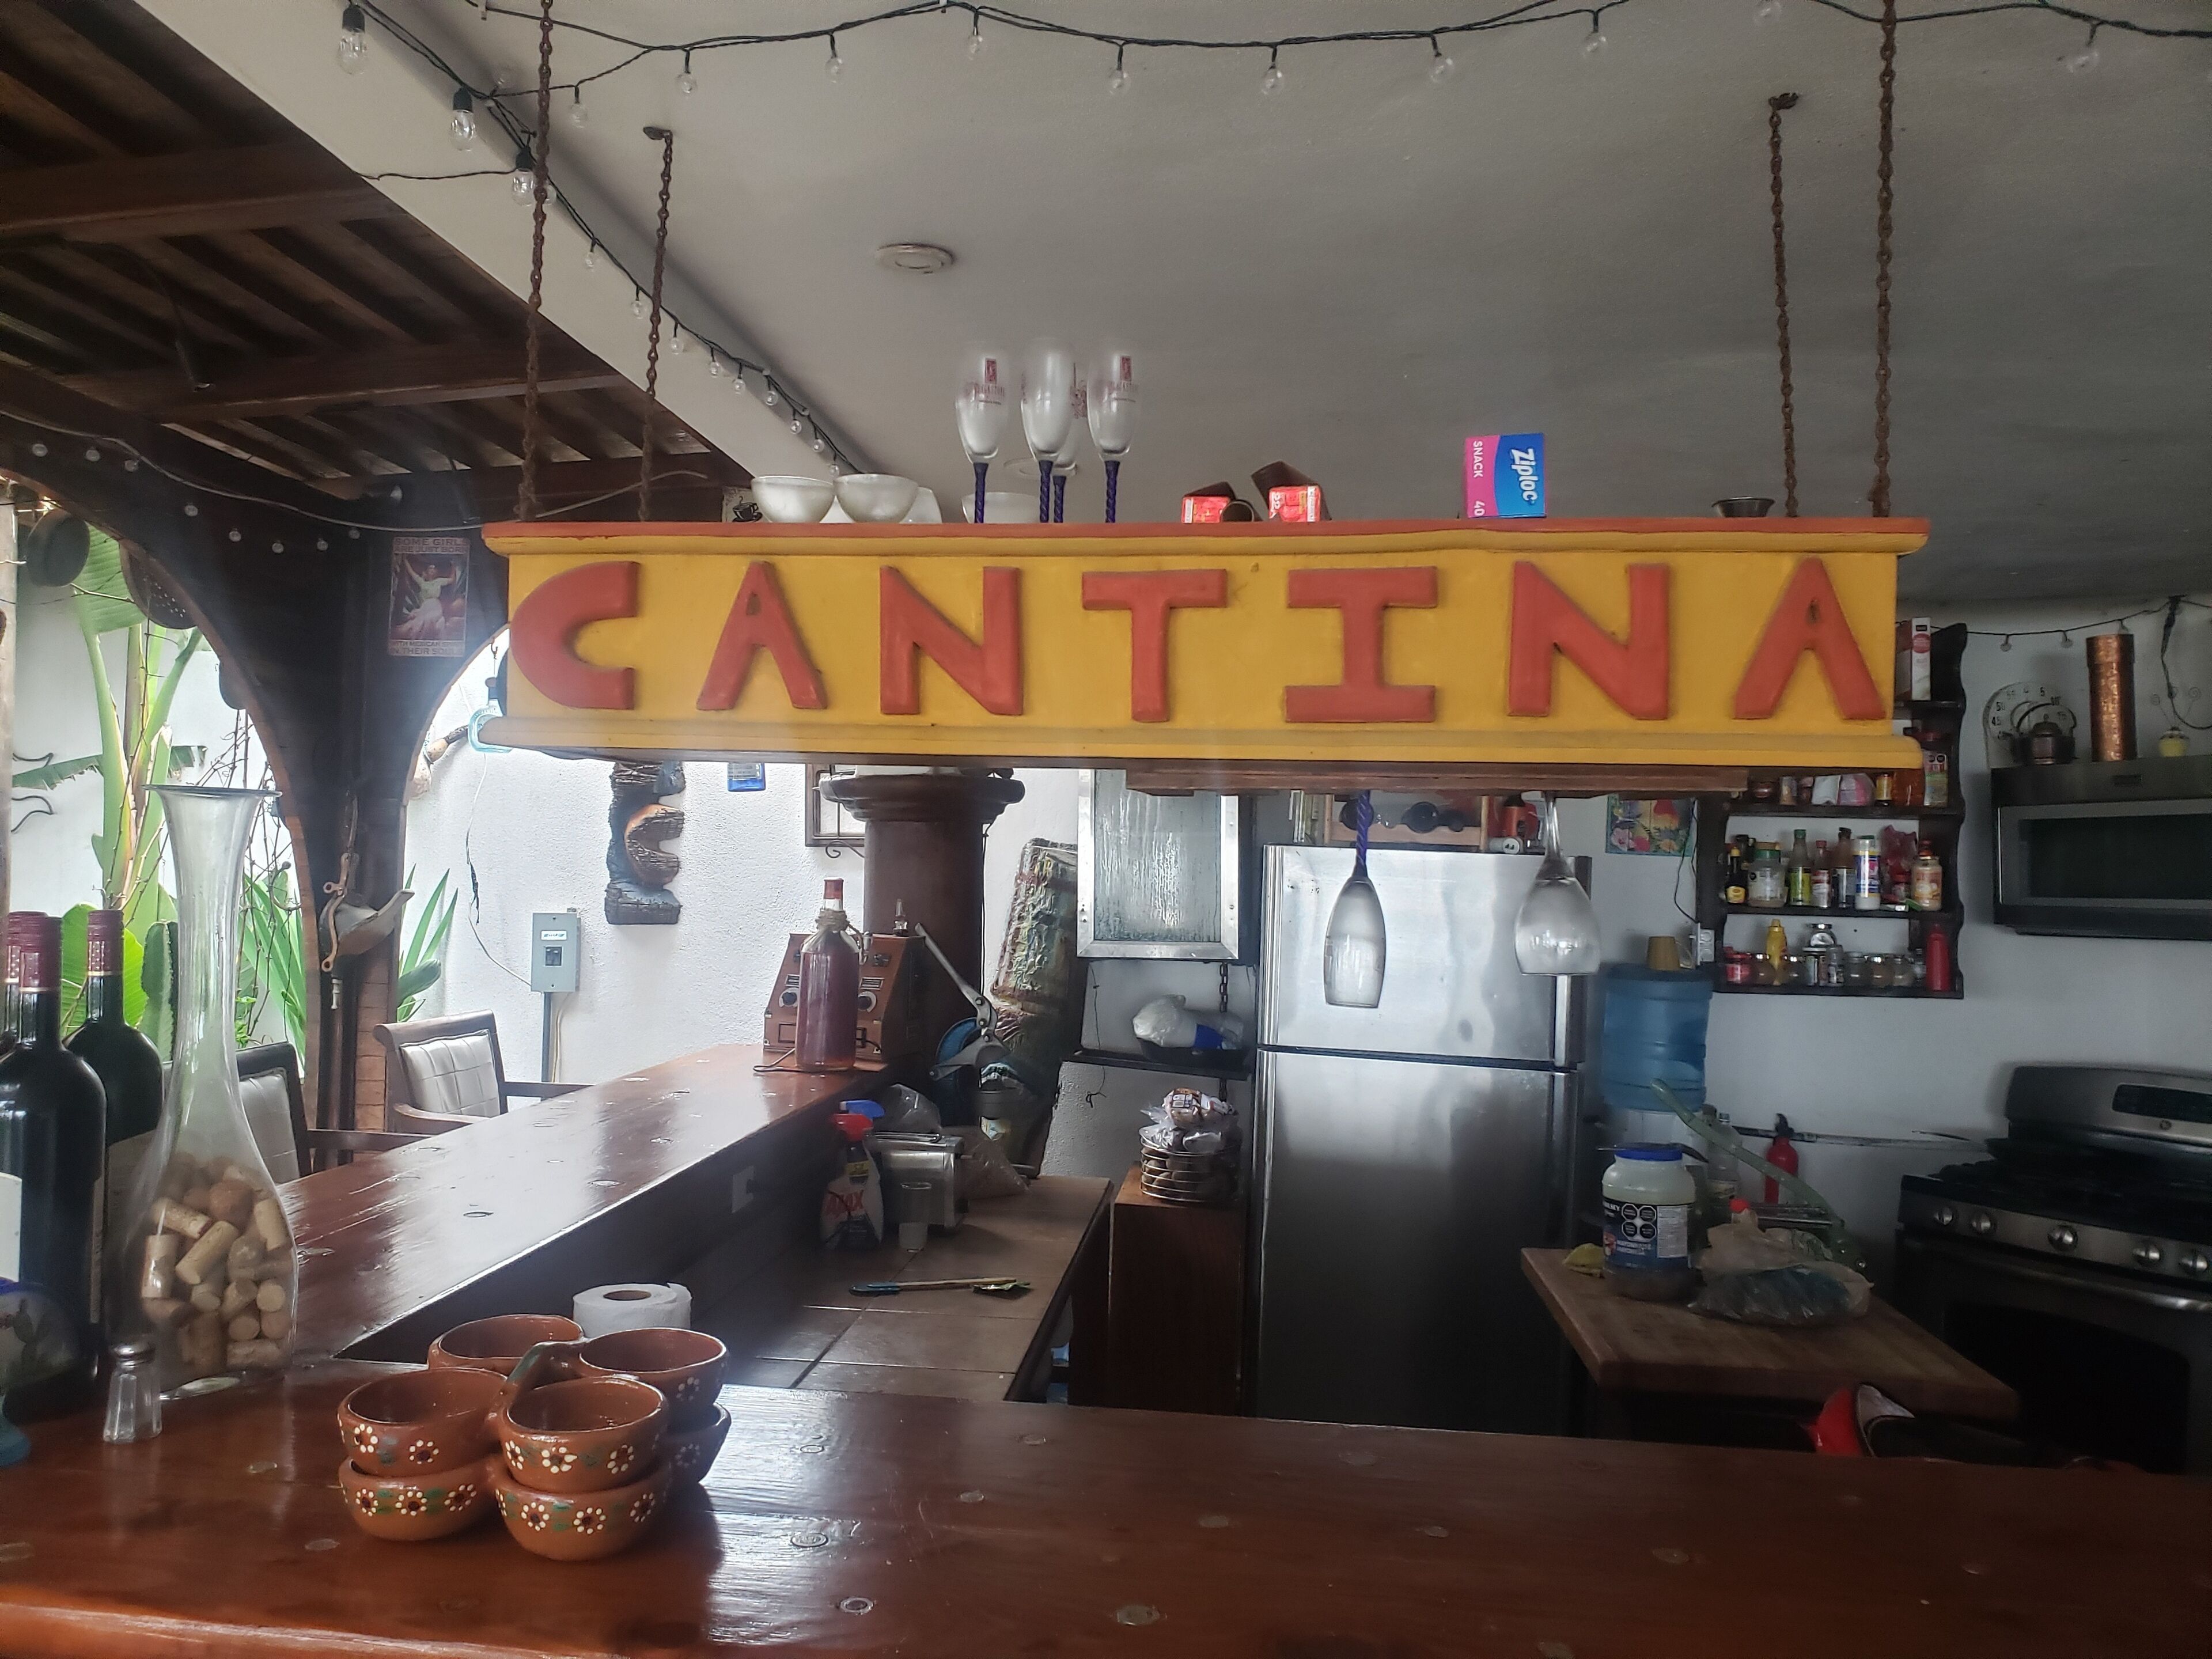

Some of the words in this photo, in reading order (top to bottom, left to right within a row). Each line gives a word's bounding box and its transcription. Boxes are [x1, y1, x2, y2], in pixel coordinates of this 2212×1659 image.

[1473, 440, 1483, 478] SNACK
[1510, 448, 1539, 501] Ziploc
[1474, 500, 1485, 517] 40
[433, 538, 468, 547] GIRLS
[402, 647, 430, 656] THEIR
[510, 556, 1887, 724] CANTINA
